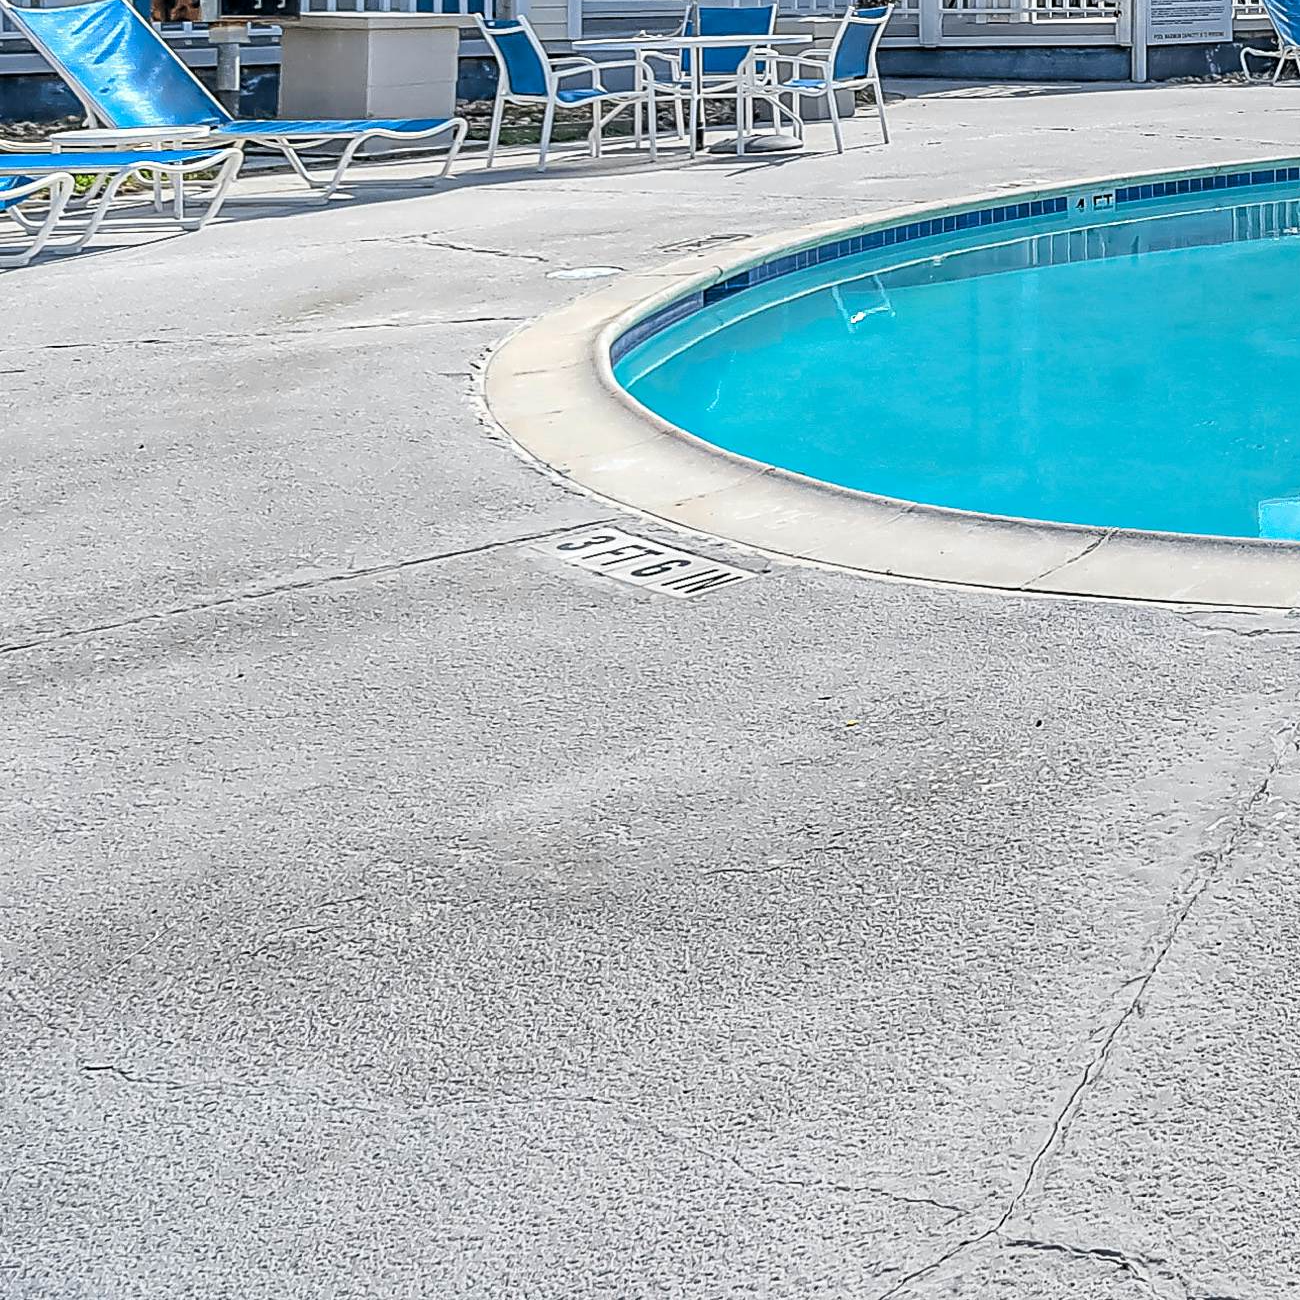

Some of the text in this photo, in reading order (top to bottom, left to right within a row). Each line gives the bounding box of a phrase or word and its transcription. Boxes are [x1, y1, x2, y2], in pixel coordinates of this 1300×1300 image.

[1075, 198, 1085, 209] 4
[556, 535, 744, 594] 3 FT 6 IN
